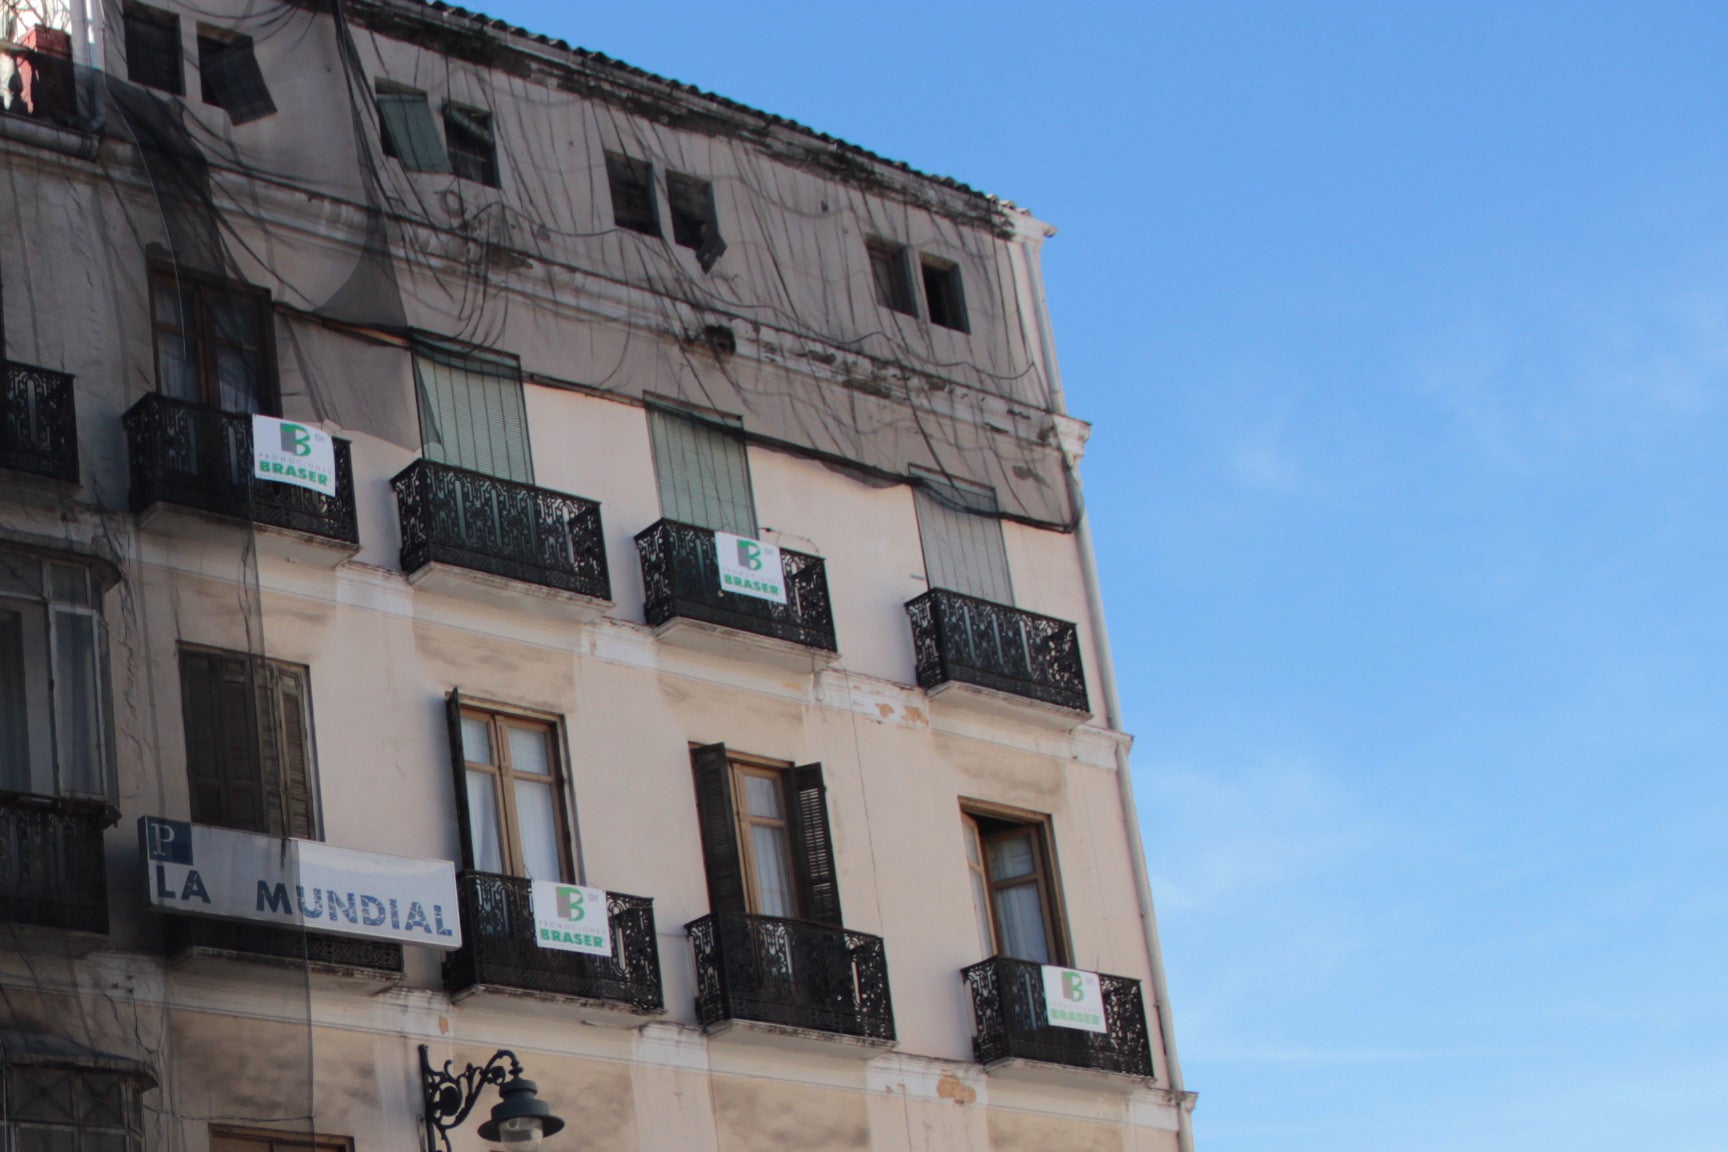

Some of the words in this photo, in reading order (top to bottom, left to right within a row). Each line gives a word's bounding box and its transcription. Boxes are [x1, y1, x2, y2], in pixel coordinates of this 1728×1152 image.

[259, 460, 329, 486] BRASER
[724, 574, 779, 595] BRASER
[150, 822, 175, 857] P
[155, 865, 212, 904] LA
[256, 879, 453, 937] MUNDIAL
[540, 928, 604, 947] BRASER
